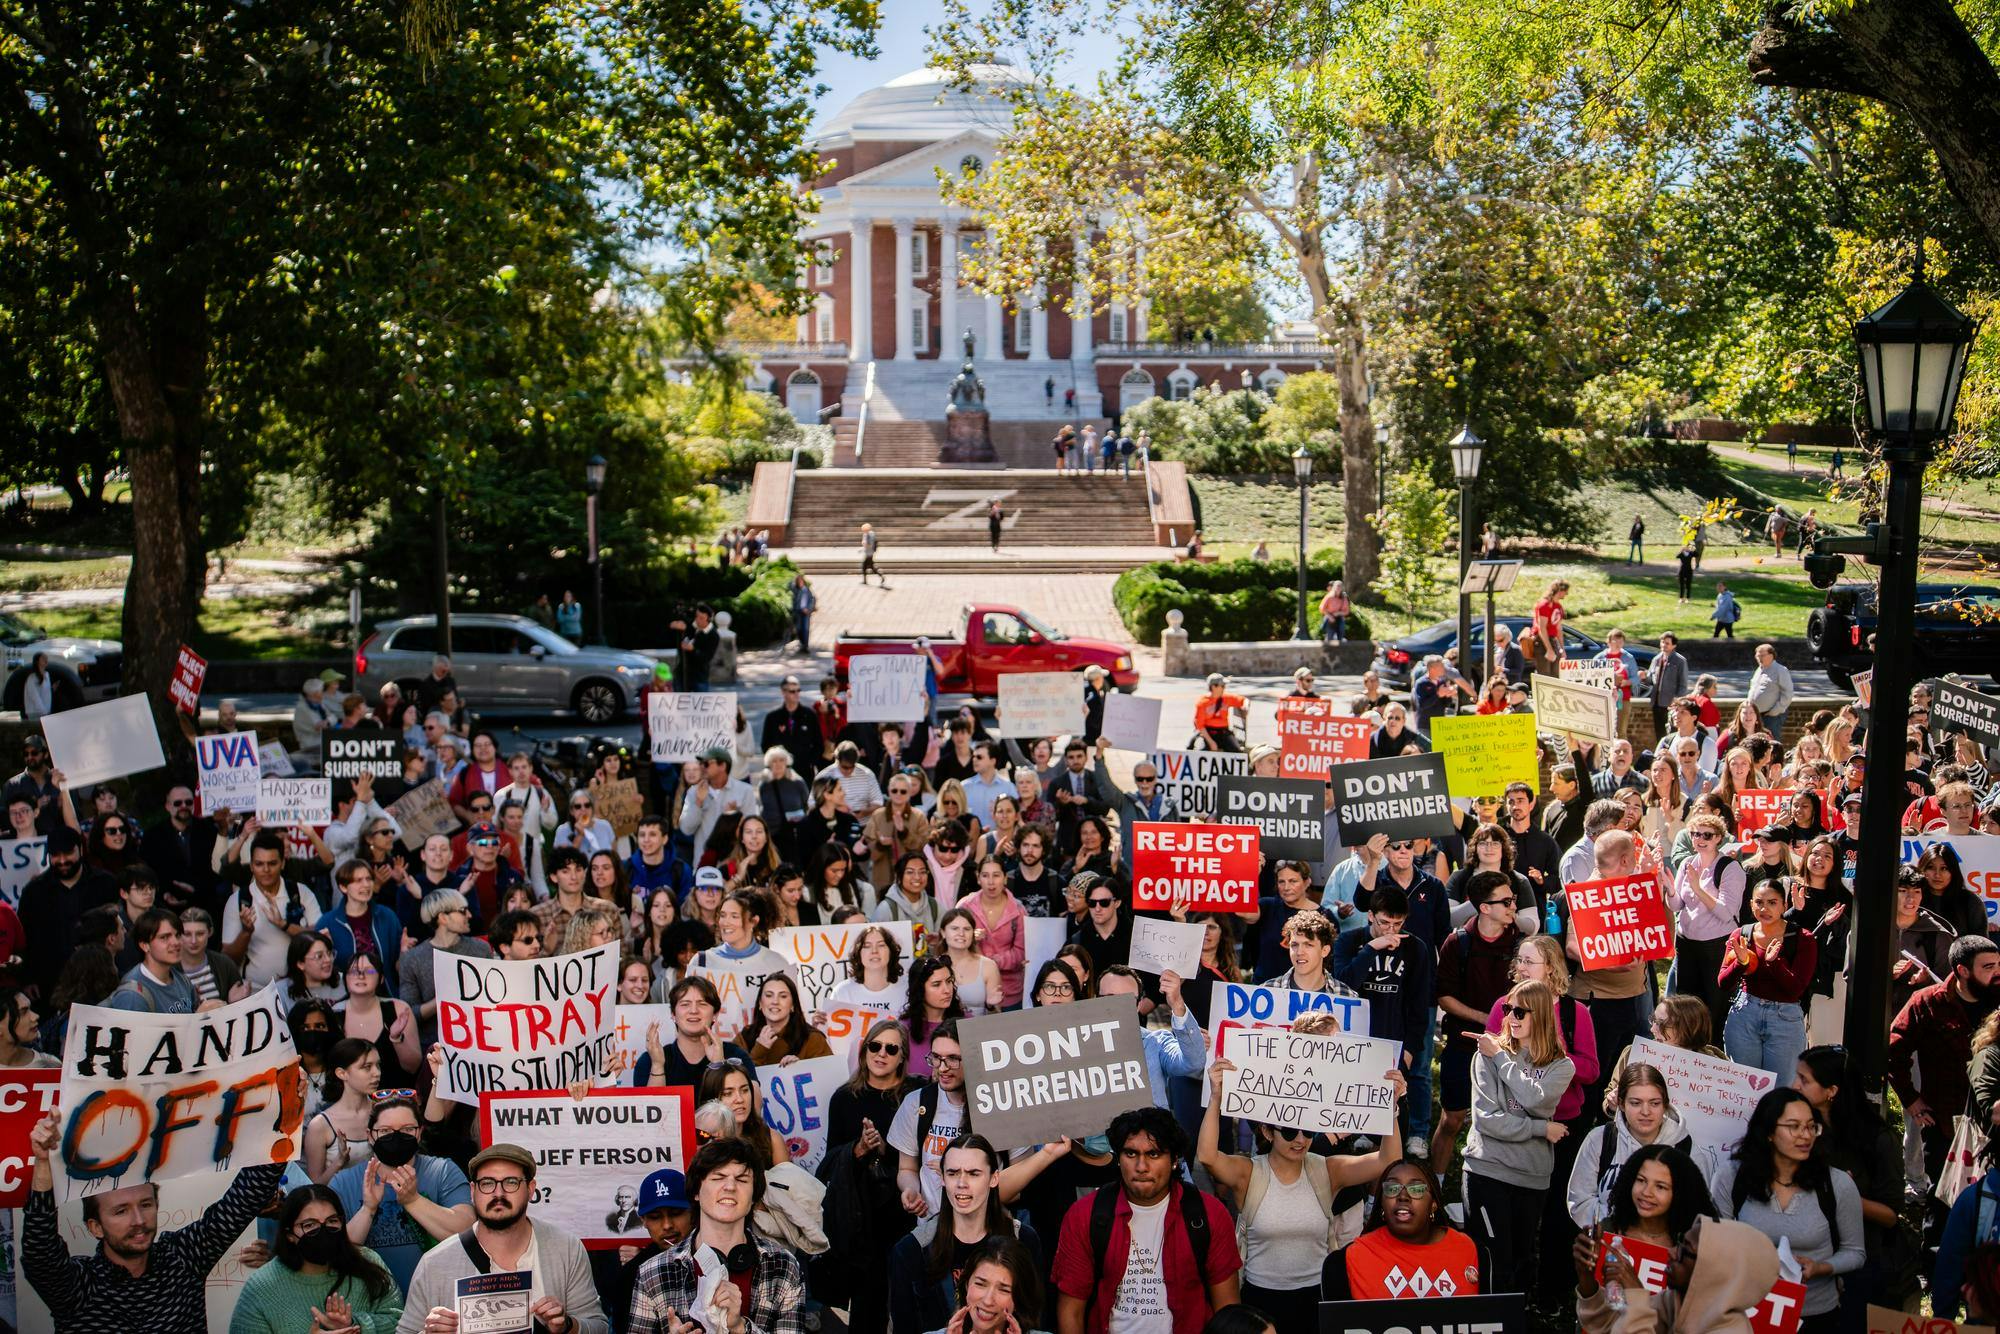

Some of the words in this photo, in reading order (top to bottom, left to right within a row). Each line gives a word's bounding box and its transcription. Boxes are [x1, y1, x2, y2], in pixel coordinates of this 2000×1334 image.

[179, 650, 206, 677] REJECT
[885, 655, 925, 673] TRUMP
[1560, 660, 1578, 670] UVA
[1580, 660, 1614, 670] STUDENTS
[182, 669, 194, 686] THE
[170, 678, 198, 708] COMPACT
[658, 695, 728, 711] NEVER
[1940, 690, 1996, 719] DON'T
[1285, 719, 1369, 739] REJECT
[1934, 703, 2000, 737] SURRENDER
[198, 735, 258, 771] UVA
[330, 740, 396, 757] DON'T
[652, 729, 734, 755] university
[1308, 738, 1344, 754] THE
[200, 769, 259, 788] WORKERS
[324, 760, 402, 778] SURRENDER
[1152, 753, 1195, 782] UVA
[1198, 756, 1246, 782] CANT
[261, 782, 309, 797] HANDS
[1345, 769, 1435, 799] DON'T
[283, 798, 305, 807] OUR
[1181, 784, 1216, 815] BOU
[1229, 790, 1314, 814] DON'T
[1340, 794, 1449, 825] SURRENDER
[1137, 831, 1256, 855] REJECT
[1170, 856, 1222, 875] THE
[1137, 877, 1255, 905] COMPACT
[1569, 880, 1655, 911] REJECT
[1600, 908, 1639, 927] THE
[793, 929, 849, 964] UV
[1142, 923, 1176, 945] Free
[1582, 925, 1667, 960] COMPACT
[457, 958, 507, 1004] DO
[534, 950, 605, 1001] NOT
[440, 984, 610, 1054] BETRAY
[1227, 984, 1274, 1020] DO
[1289, 991, 1361, 1032] NOT
[77, 994, 292, 1079] HANDS
[980, 1020, 1121, 1073] DON'T
[1238, 1033, 1280, 1059] THE
[1286, 1035, 1372, 1065] "COMPACT"
[440, 1049, 506, 1099] YOUR
[512, 1033, 616, 1091] STUDENTS
[1283, 1063, 1295, 1075] IS
[1304, 1066, 1314, 1077] A
[1640, 1043, 1657, 1057] This
[1662, 1053, 1676, 1063] girl
[1680, 1058, 1687, 1066] is
[1693, 1058, 1708, 1070] the
[1712, 1065, 1749, 1080] nastiest
[1668, 1065, 1689, 1079] bitch
[975, 1060, 1146, 1115] SURRENDER
[1237, 1068, 1323, 1102] RANSOM
[1334, 1082, 1393, 1107] LETTER!
[1667, 1077, 1680, 1089] Do
[1688, 1082, 1713, 1094] NOT
[1717, 1089, 1747, 1106] TRUST
[1748, 1097, 1760, 1110] HE
[62, 1062, 304, 1187] OFF!
[495, 1106, 564, 1127] WHAT
[575, 1105, 663, 1126] WOULD
[1225, 1092, 1256, 1114] DO
[1266, 1102, 1309, 1126] NOT
[1318, 1108, 1371, 1131] SIGN!
[930, 1125, 963, 1138] NIVERS
[530, 1186, 552, 1204] O?
[654, 1180, 670, 1197] LA
[1141, 1277, 1164, 1286] ques
[1141, 1286, 1159, 1295] hot,
[1126, 1296, 1158, 1306] cheese,
[1131, 1306, 1138, 1315] &
[1141, 1307, 1166, 1316] guac.
